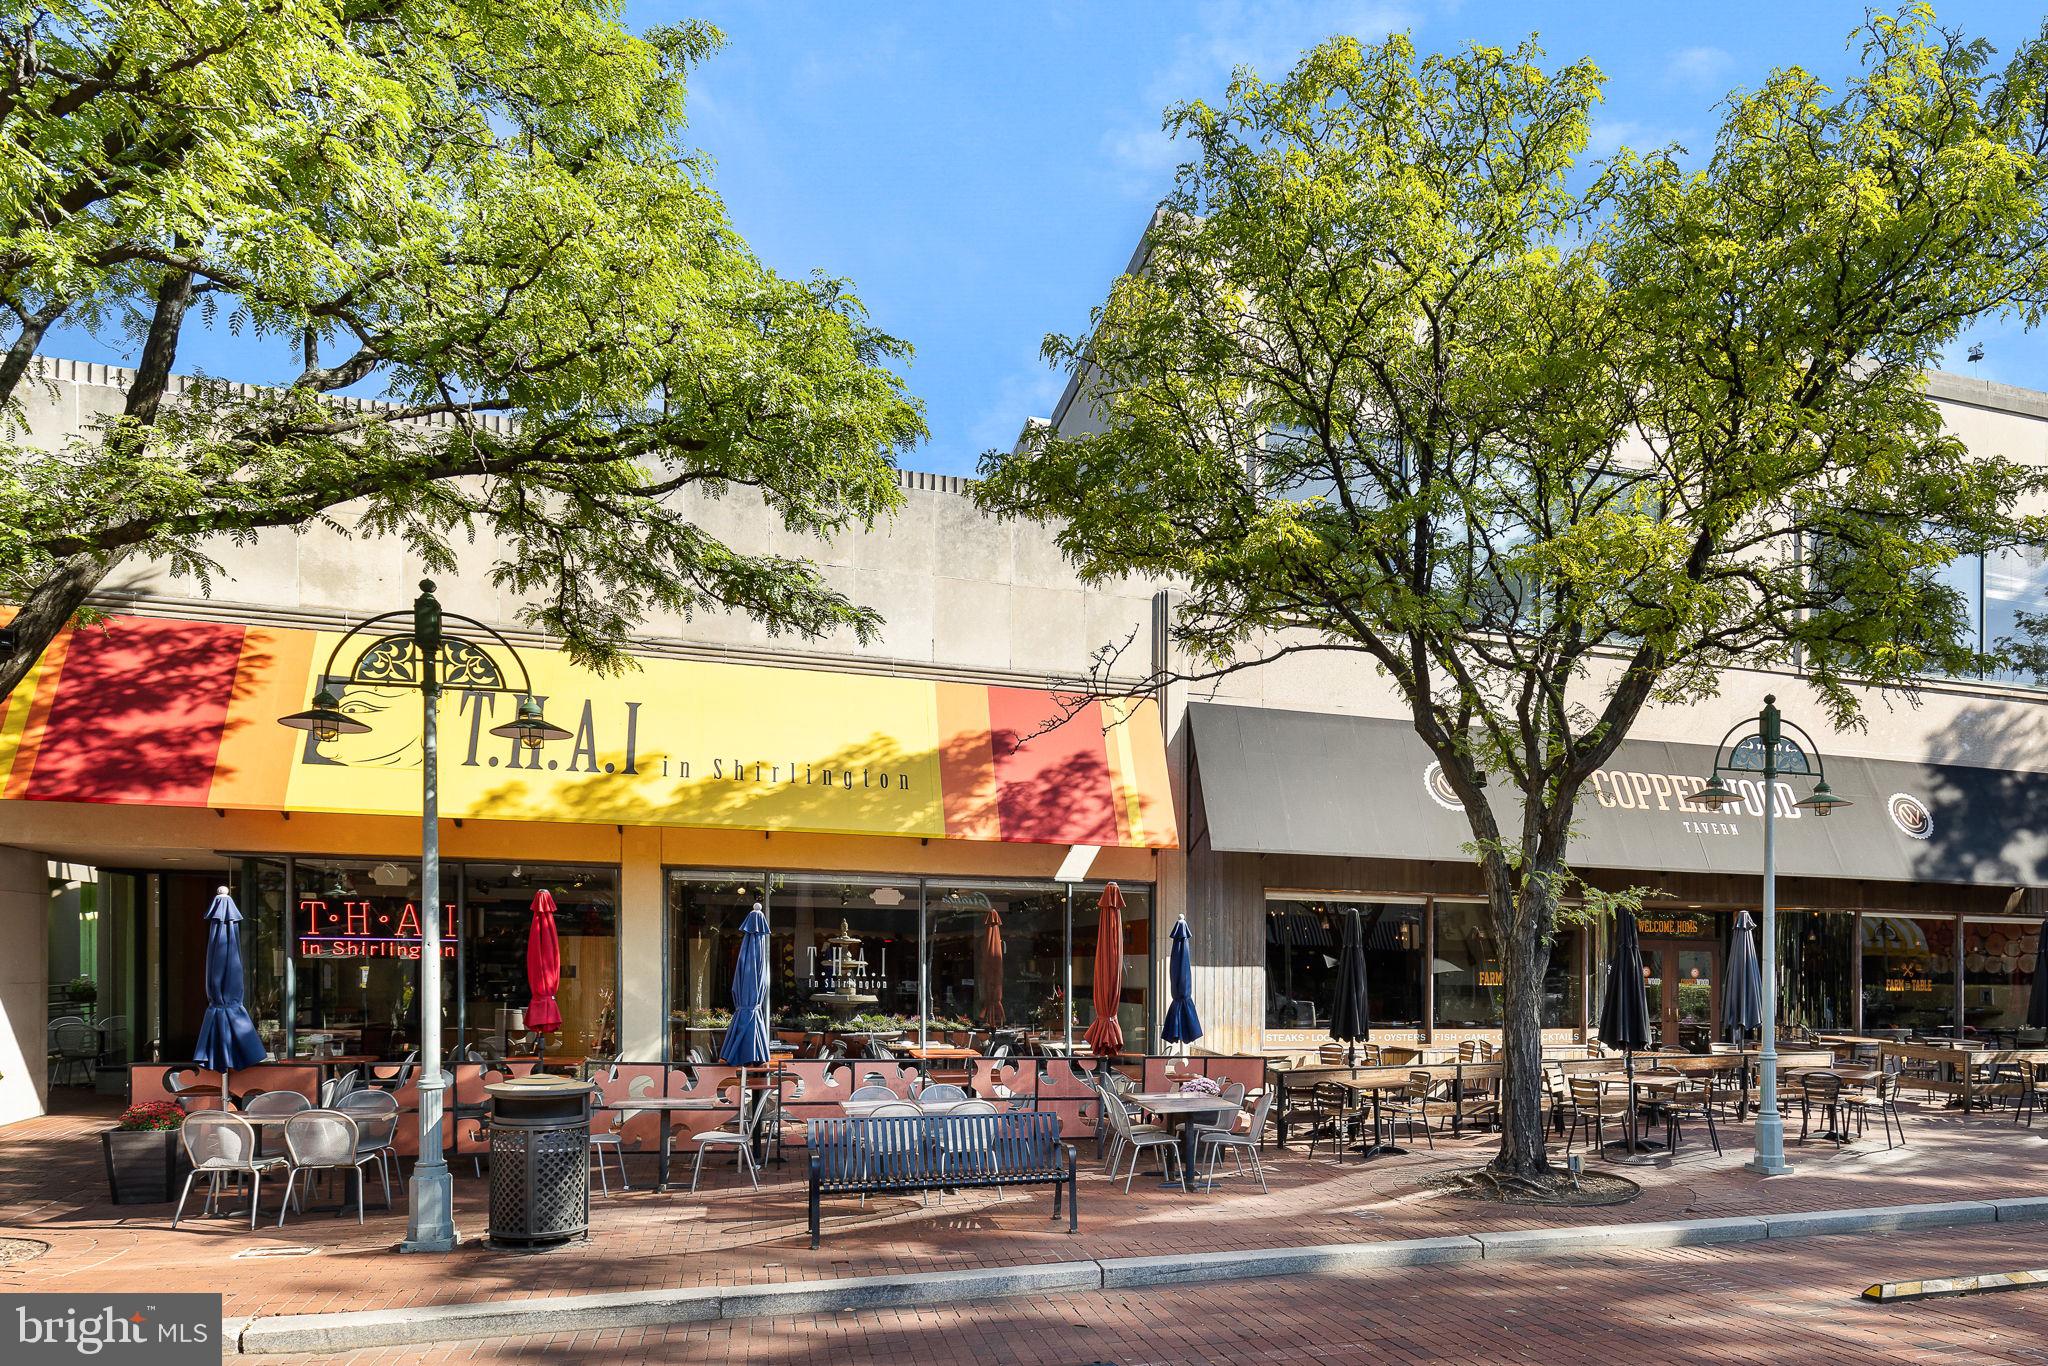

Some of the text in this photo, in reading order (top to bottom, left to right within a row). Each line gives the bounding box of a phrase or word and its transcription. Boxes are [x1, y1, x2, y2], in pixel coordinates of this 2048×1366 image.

[662, 755, 690, 778] in
[713, 758, 910, 790] Shirlington
[1683, 821, 1739, 836] TAVERN
[1638, 920, 1675, 933] WELCOME
[332, 941, 455, 959] Shirlingn
[1479, 971, 1503, 986] FARM
[1885, 979, 1904, 991] FARM
[1912, 979, 1932, 991] TABLE
[1265, 1033, 1304, 1042] STEAKS
[1384, 1033, 1426, 1042] OYSTERS
[1434, 1033, 1457, 1041] FISH
[1464, 1033, 1490, 1041] GAME
